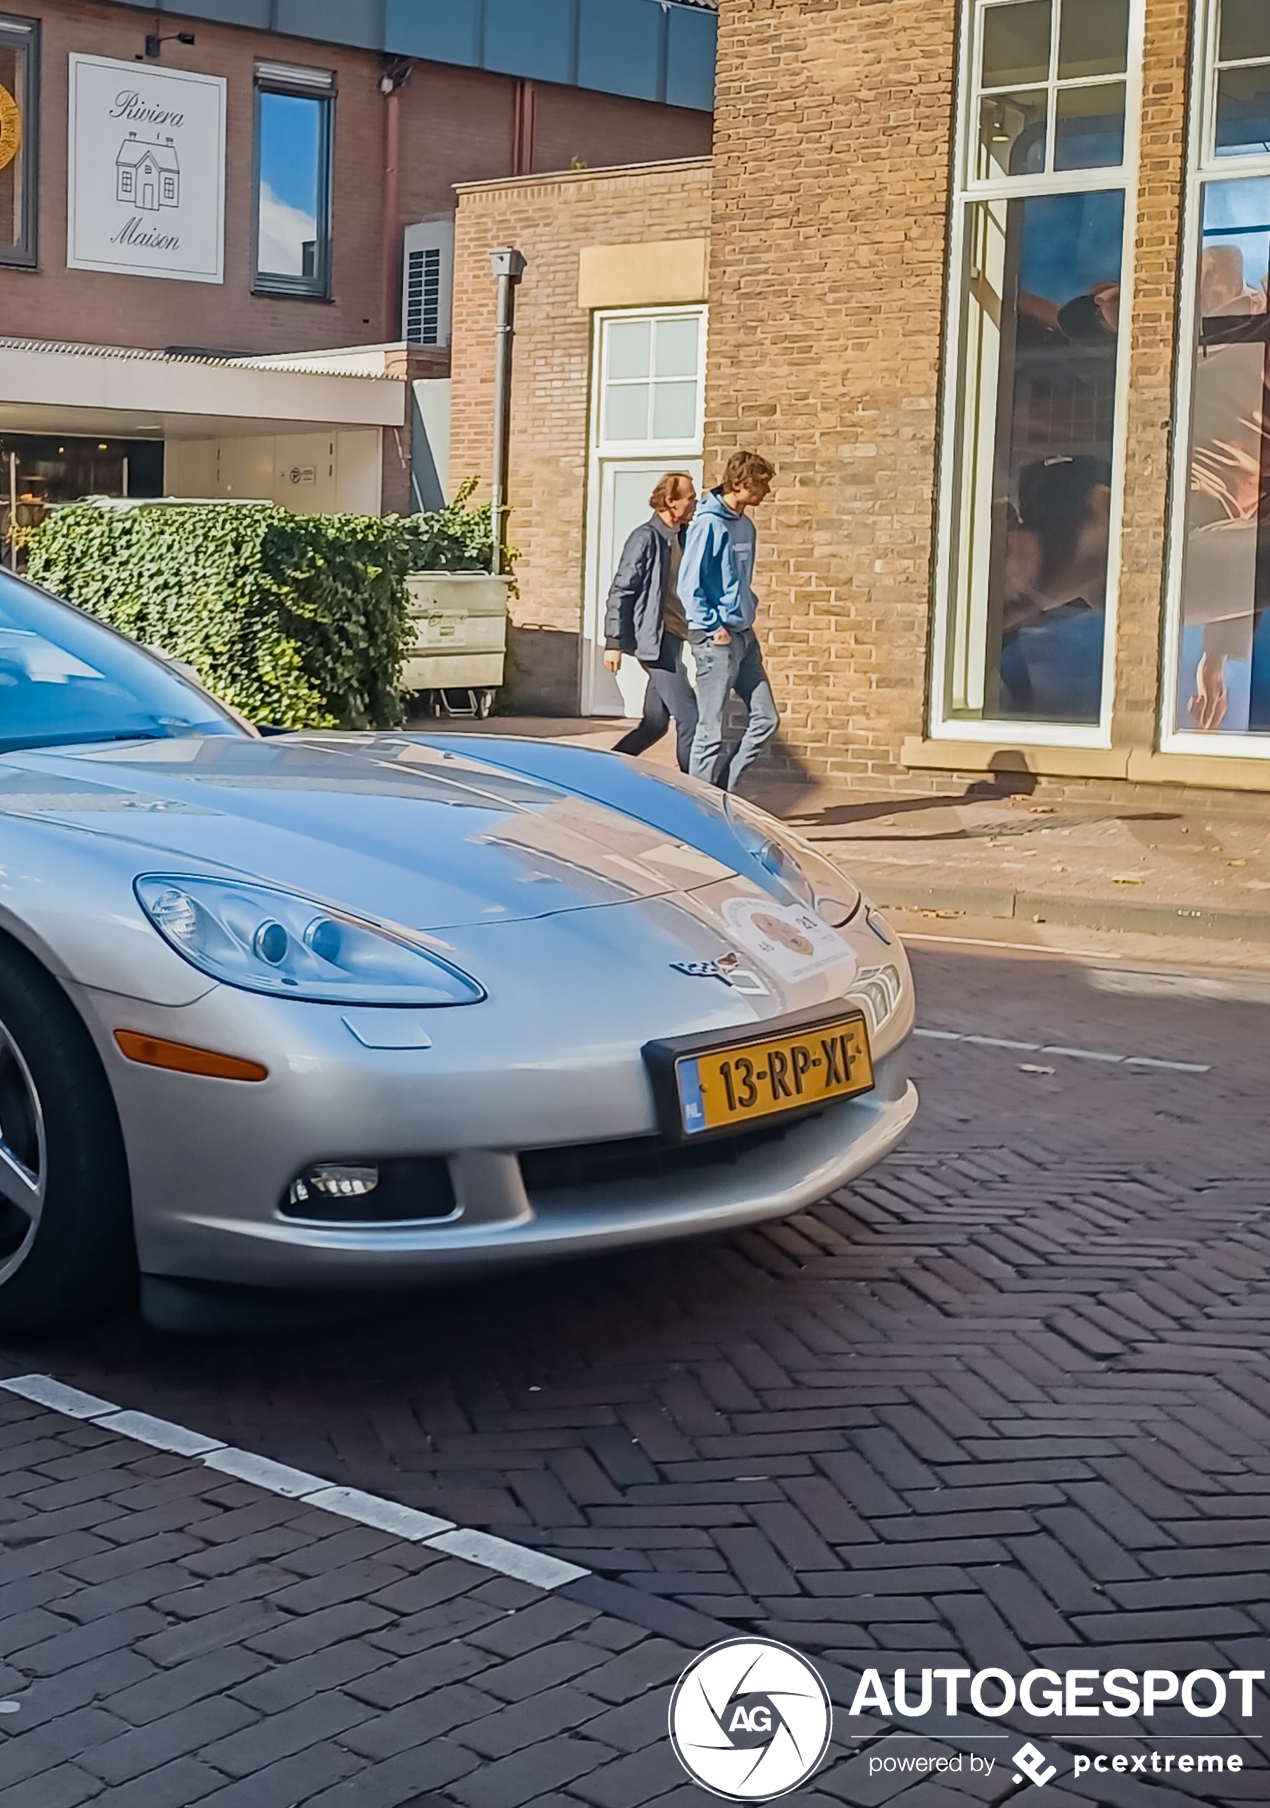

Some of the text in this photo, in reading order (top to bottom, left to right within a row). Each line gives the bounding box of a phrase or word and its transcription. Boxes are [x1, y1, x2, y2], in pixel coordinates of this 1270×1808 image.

[109, 90, 184, 127] Riviera
[110, 216, 180, 250] Maison
[720, 1033, 856, 1111] 13-RP-XF
[685, 1103, 702, 1119] NL
